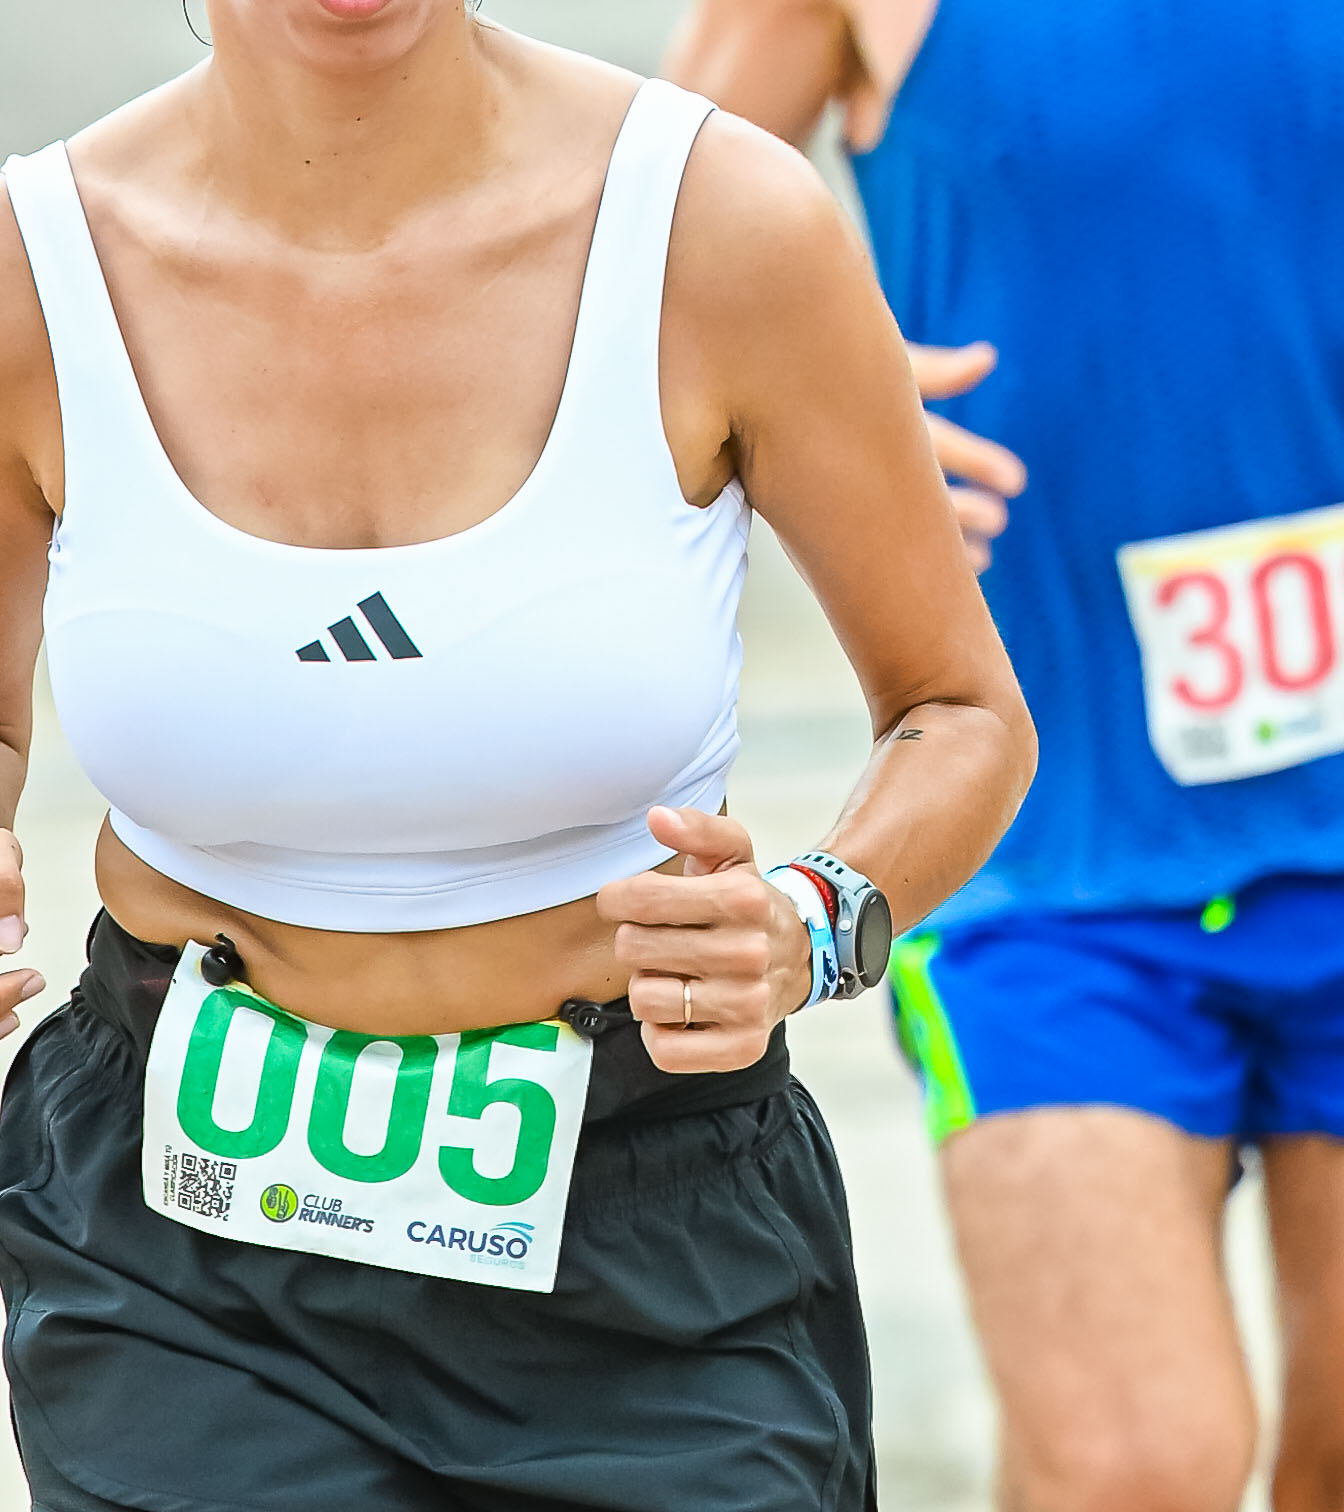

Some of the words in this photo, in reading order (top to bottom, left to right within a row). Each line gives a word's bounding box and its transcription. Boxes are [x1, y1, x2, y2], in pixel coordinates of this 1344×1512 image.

[176, 988, 560, 1207] 005
[303, 1194, 343, 1212] CLUB
[298, 1208, 375, 1233] RUNNER'S
[407, 1221, 527, 1259] CARUSO
